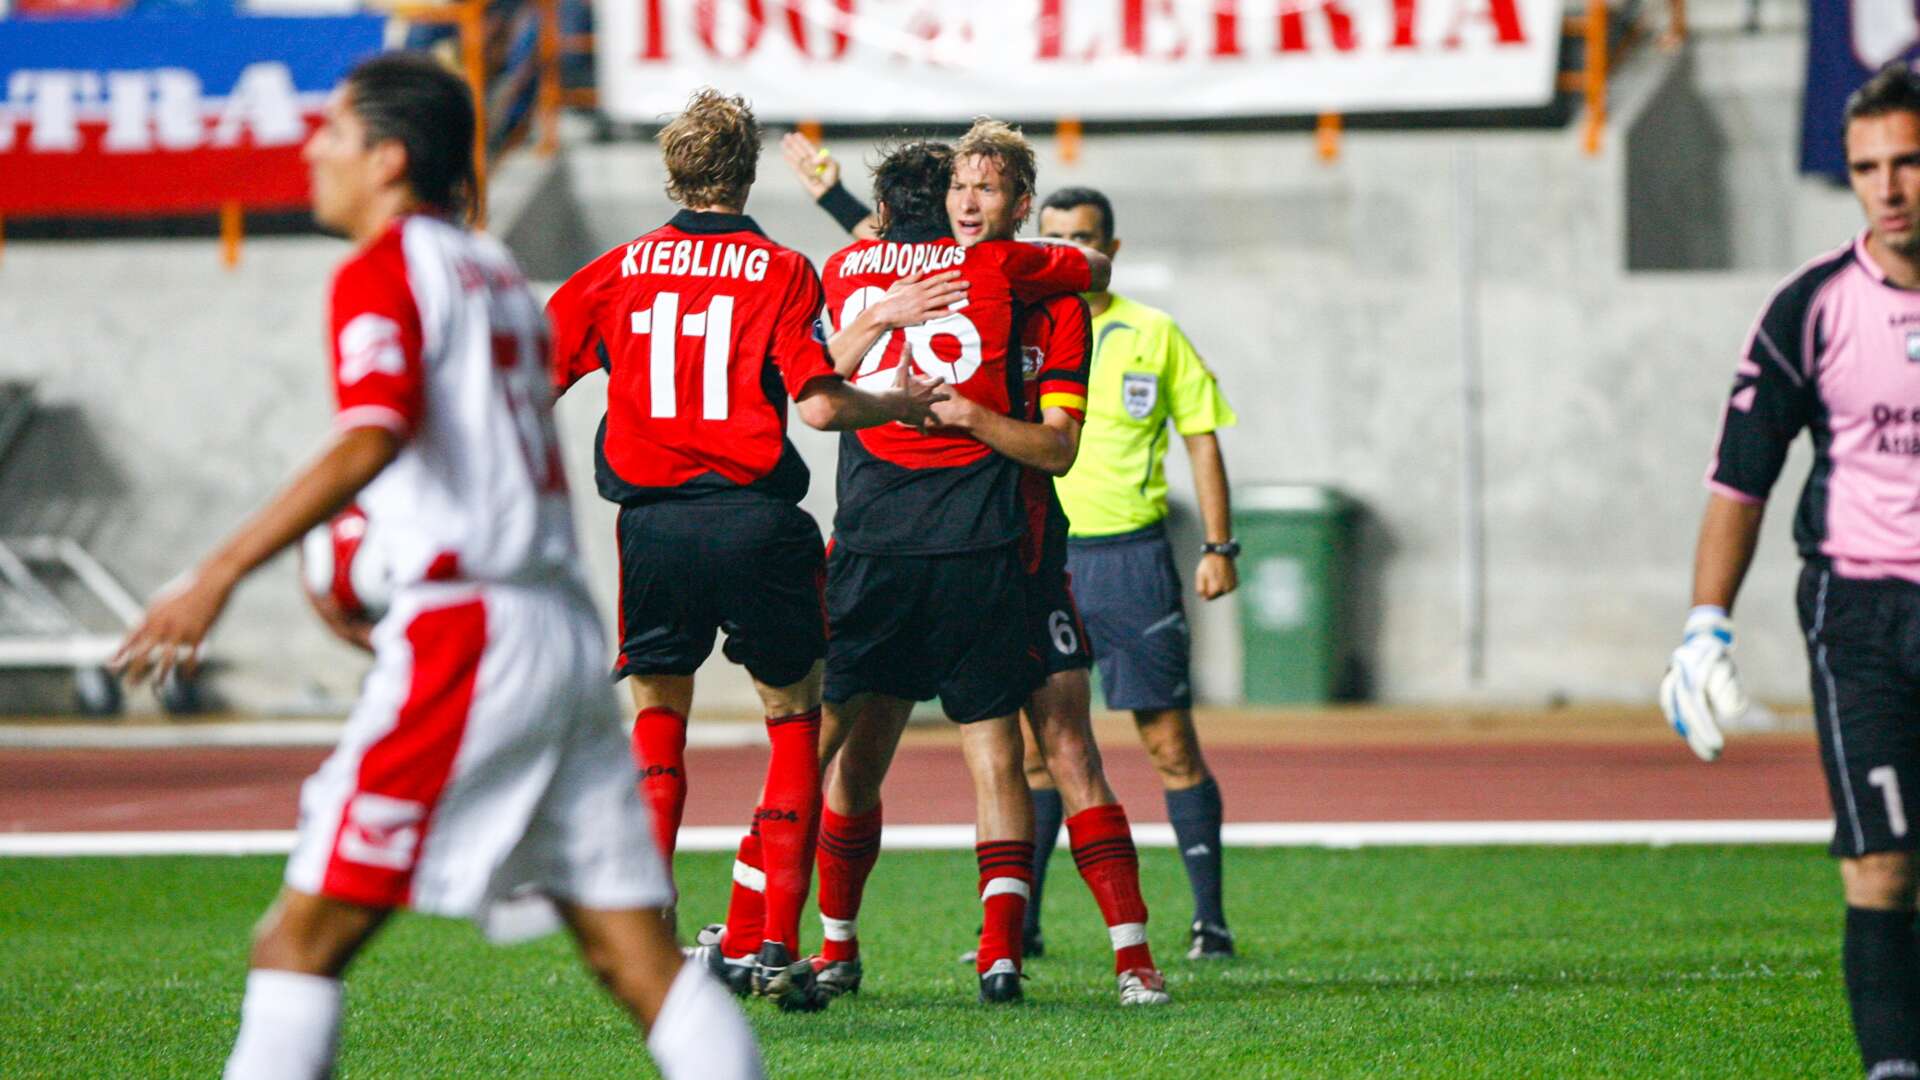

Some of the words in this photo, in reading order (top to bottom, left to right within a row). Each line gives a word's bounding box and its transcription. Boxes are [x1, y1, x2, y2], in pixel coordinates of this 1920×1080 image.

[0, 62, 304, 153] TRA
[839, 242, 967, 278] PAPADOPULOS
[631, 291, 735, 421] 11
[1048, 610, 1078, 656] 6
[1867, 765, 1908, 838] 1
